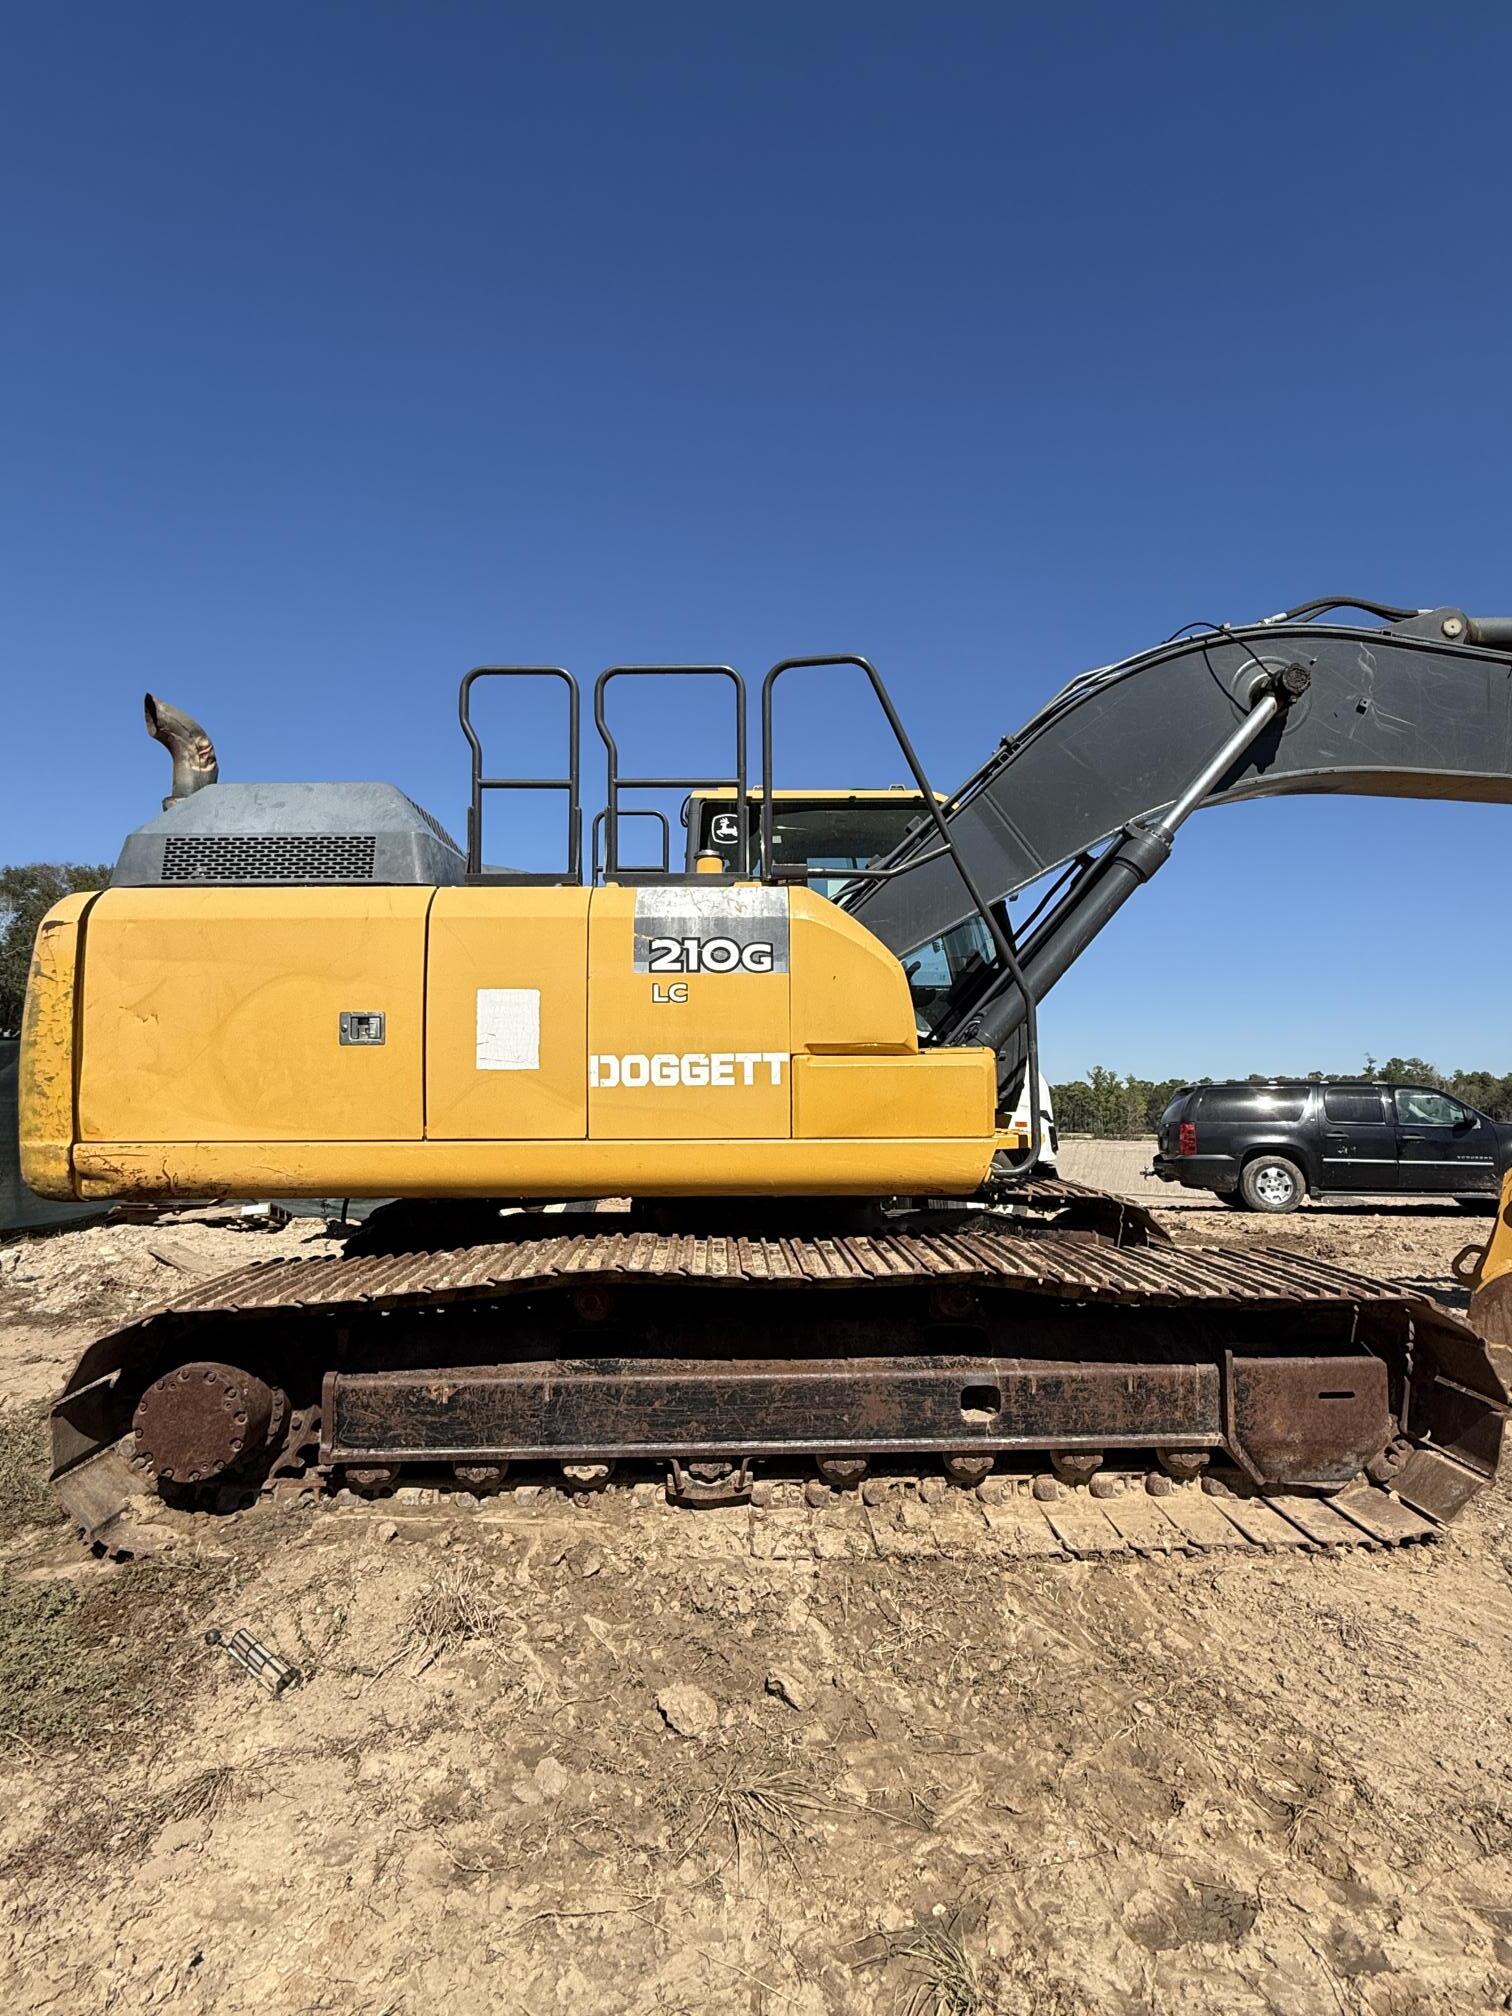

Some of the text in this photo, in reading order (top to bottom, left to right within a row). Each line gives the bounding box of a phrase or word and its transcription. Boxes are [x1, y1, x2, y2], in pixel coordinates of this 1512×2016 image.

[649, 937, 774, 973] 210G
[652, 983, 688, 1003] LC
[590, 1053, 790, 1088] DOGGETT
